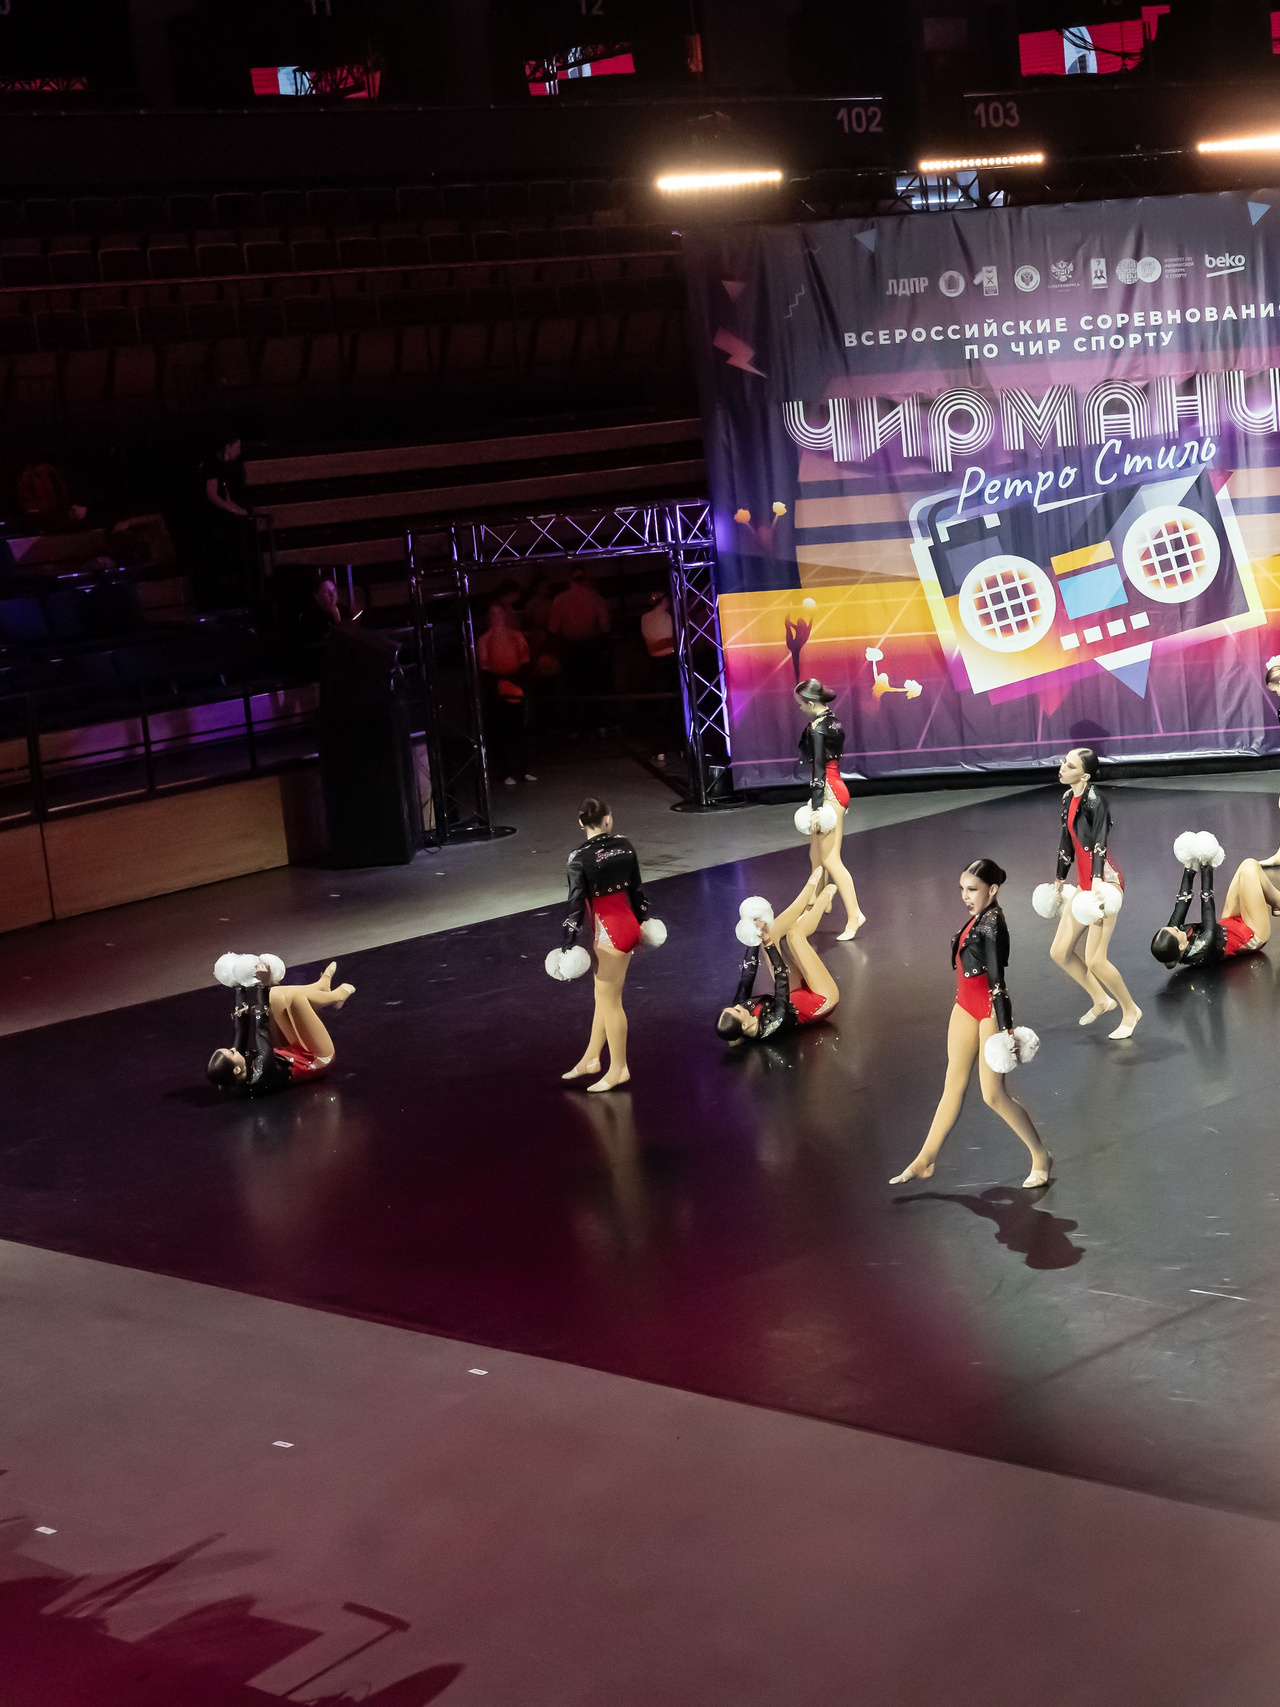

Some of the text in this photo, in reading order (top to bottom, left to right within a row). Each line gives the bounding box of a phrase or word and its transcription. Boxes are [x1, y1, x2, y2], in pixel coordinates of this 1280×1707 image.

[836, 106, 883, 134] 102
[974, 101, 1020, 128] 103
[1204, 253, 1246, 268] beko
[886, 277, 929, 297] ЛДПР
[844, 317, 1068, 347] ВСЕРОССИЙСКИЕ
[965, 330, 1174, 360] ПО ЧИР СПОРТУ
[957, 437, 1217, 514] Ретро Стиль
